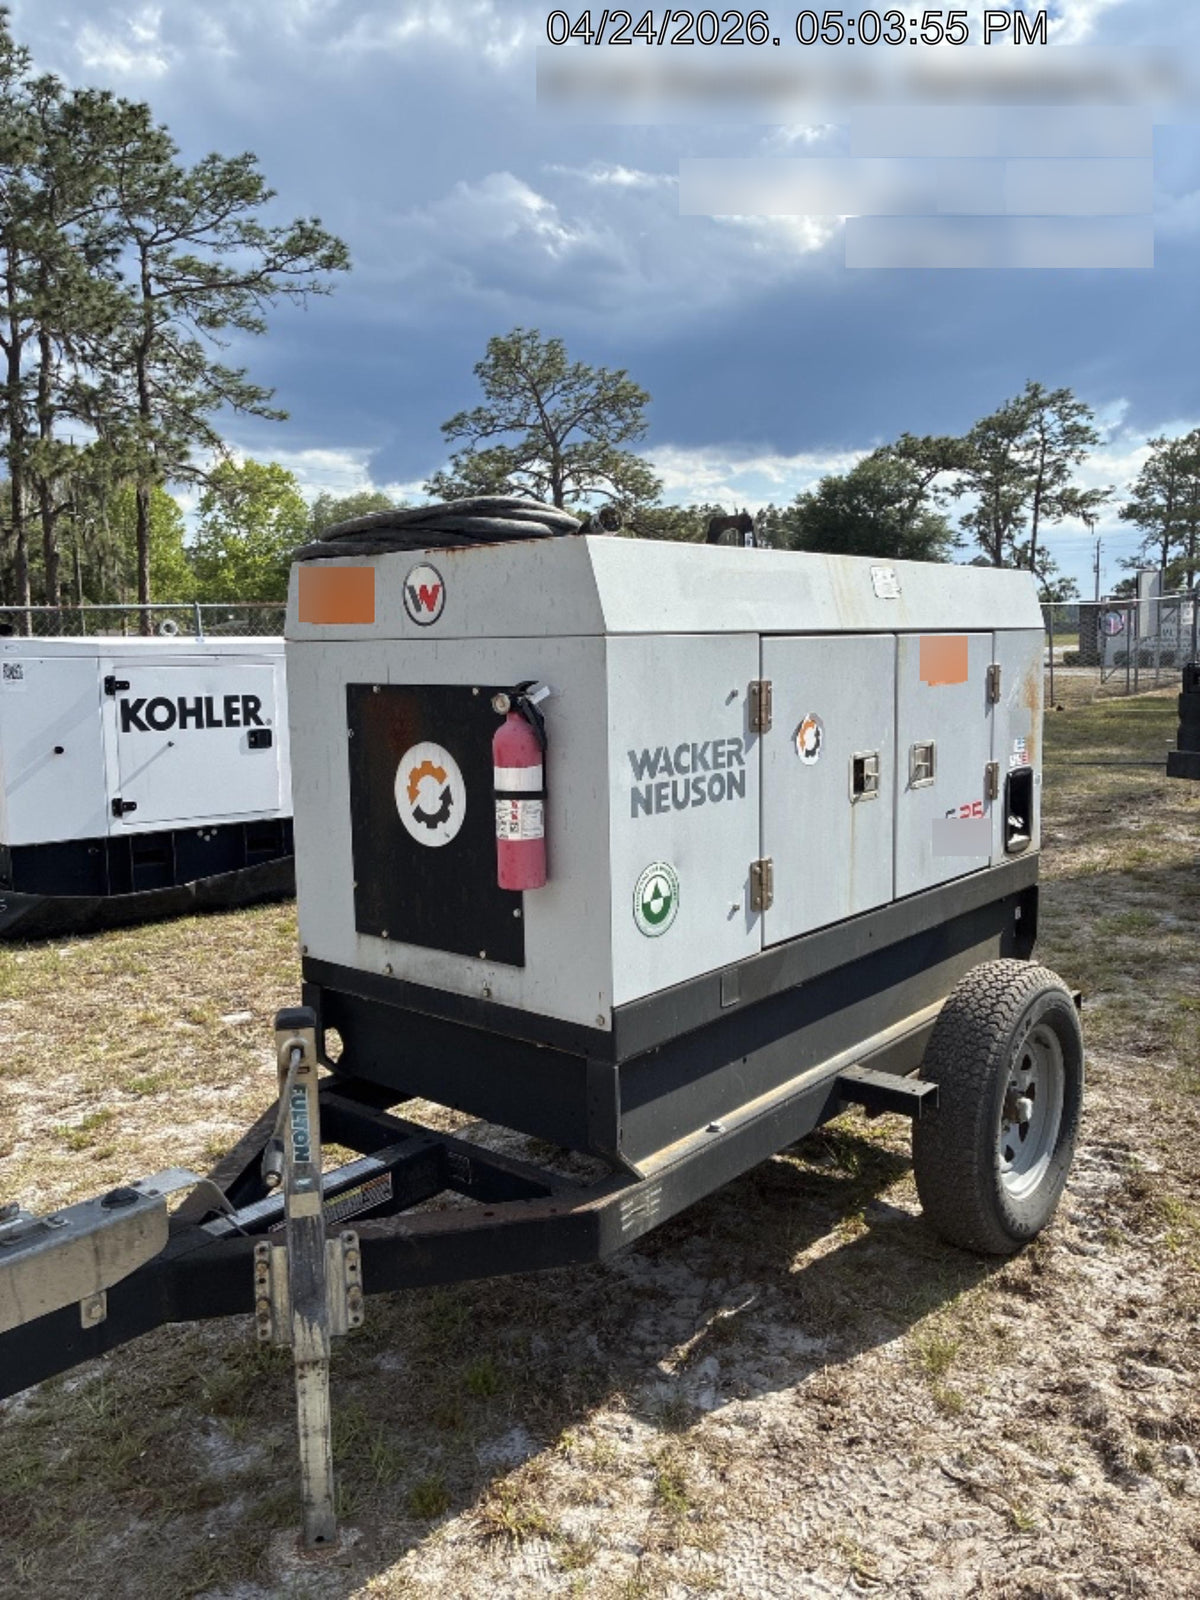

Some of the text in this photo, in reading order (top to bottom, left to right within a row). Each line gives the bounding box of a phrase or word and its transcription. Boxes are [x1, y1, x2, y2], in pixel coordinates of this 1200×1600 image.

[120, 694, 265, 733] KOHLER
[627, 737, 746, 781] WACKER
[630, 769, 746, 818] NEUSON
[290, 1083, 312, 1164] FULTON
